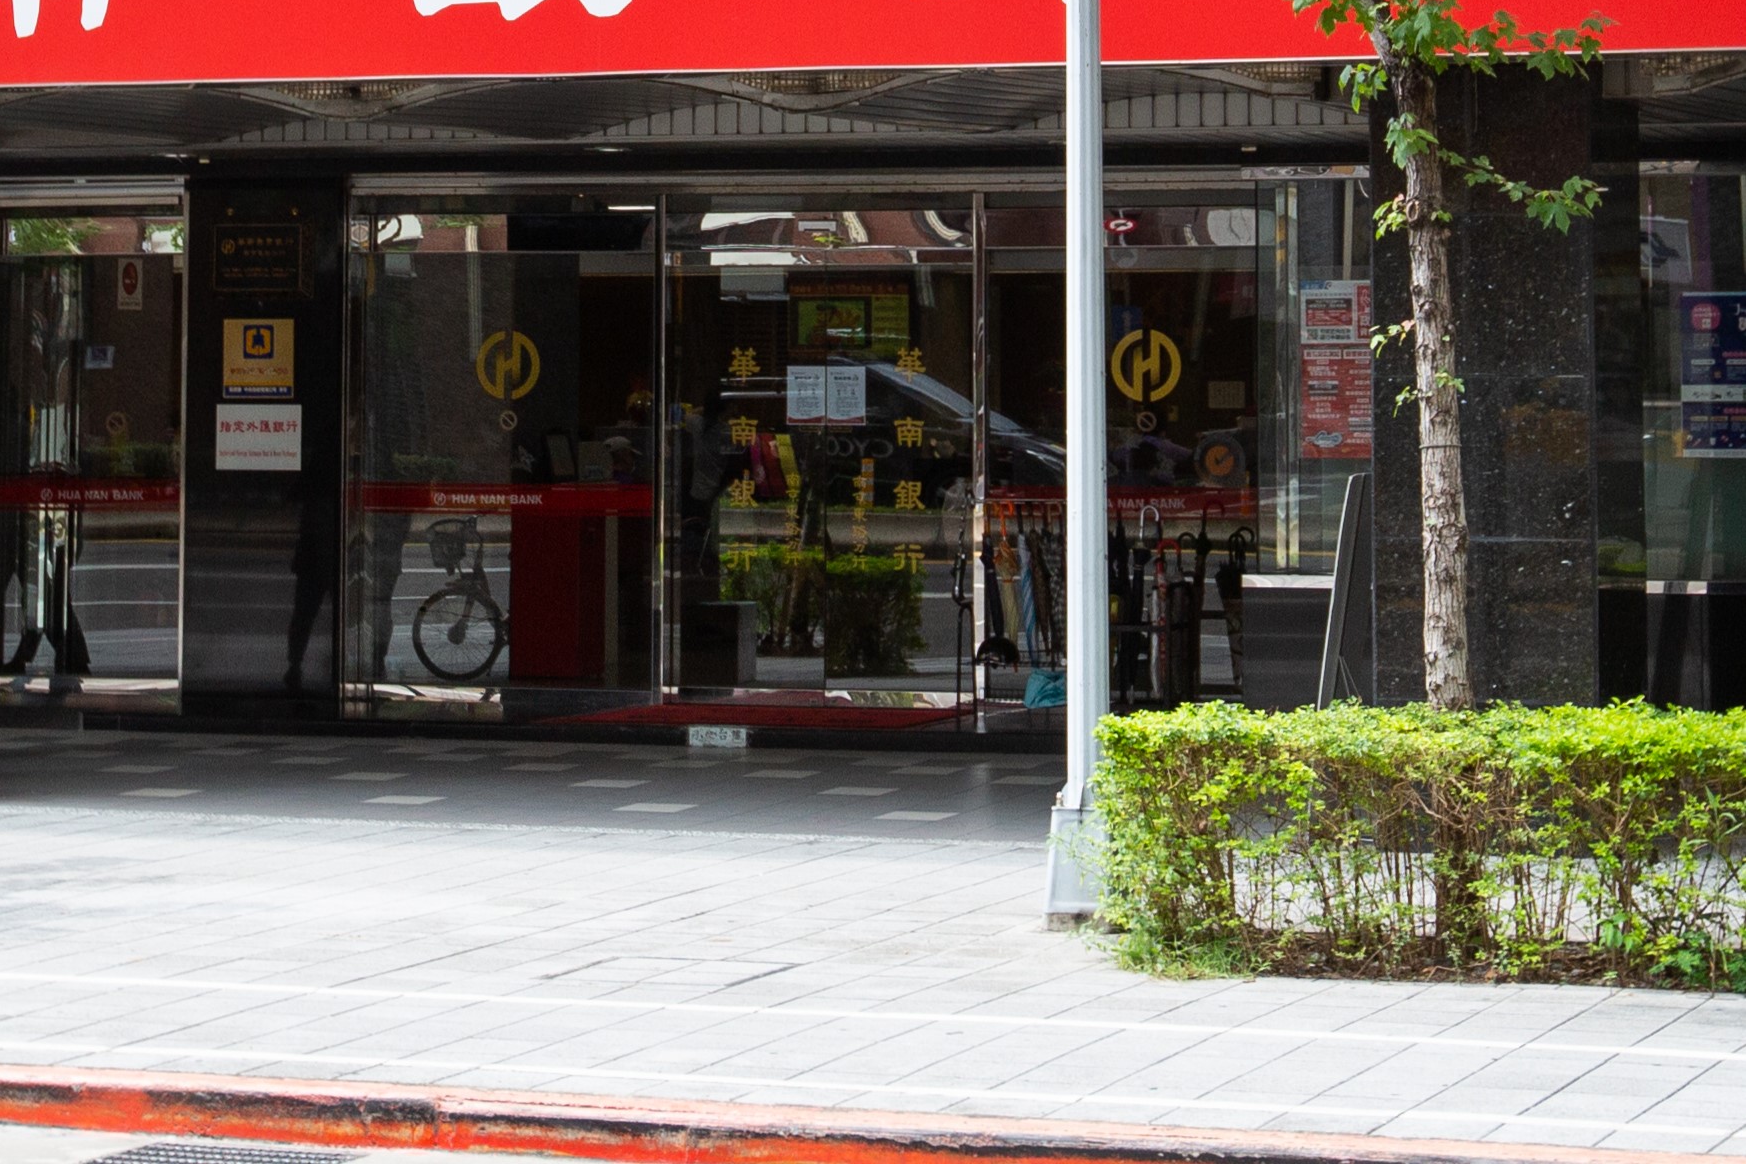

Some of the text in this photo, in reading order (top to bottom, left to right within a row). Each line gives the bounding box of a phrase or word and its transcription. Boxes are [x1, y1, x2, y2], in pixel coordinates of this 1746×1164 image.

[727, 346, 761, 573] 華南銀行
[893, 346, 926, 574] 華南銀行
[58, 490, 144, 501] HUA NAN BANK
[452, 493, 542, 505] HUA NAN BANK
[1117, 498, 1144, 509] NAN
[1150, 498, 1186, 509] BANK
